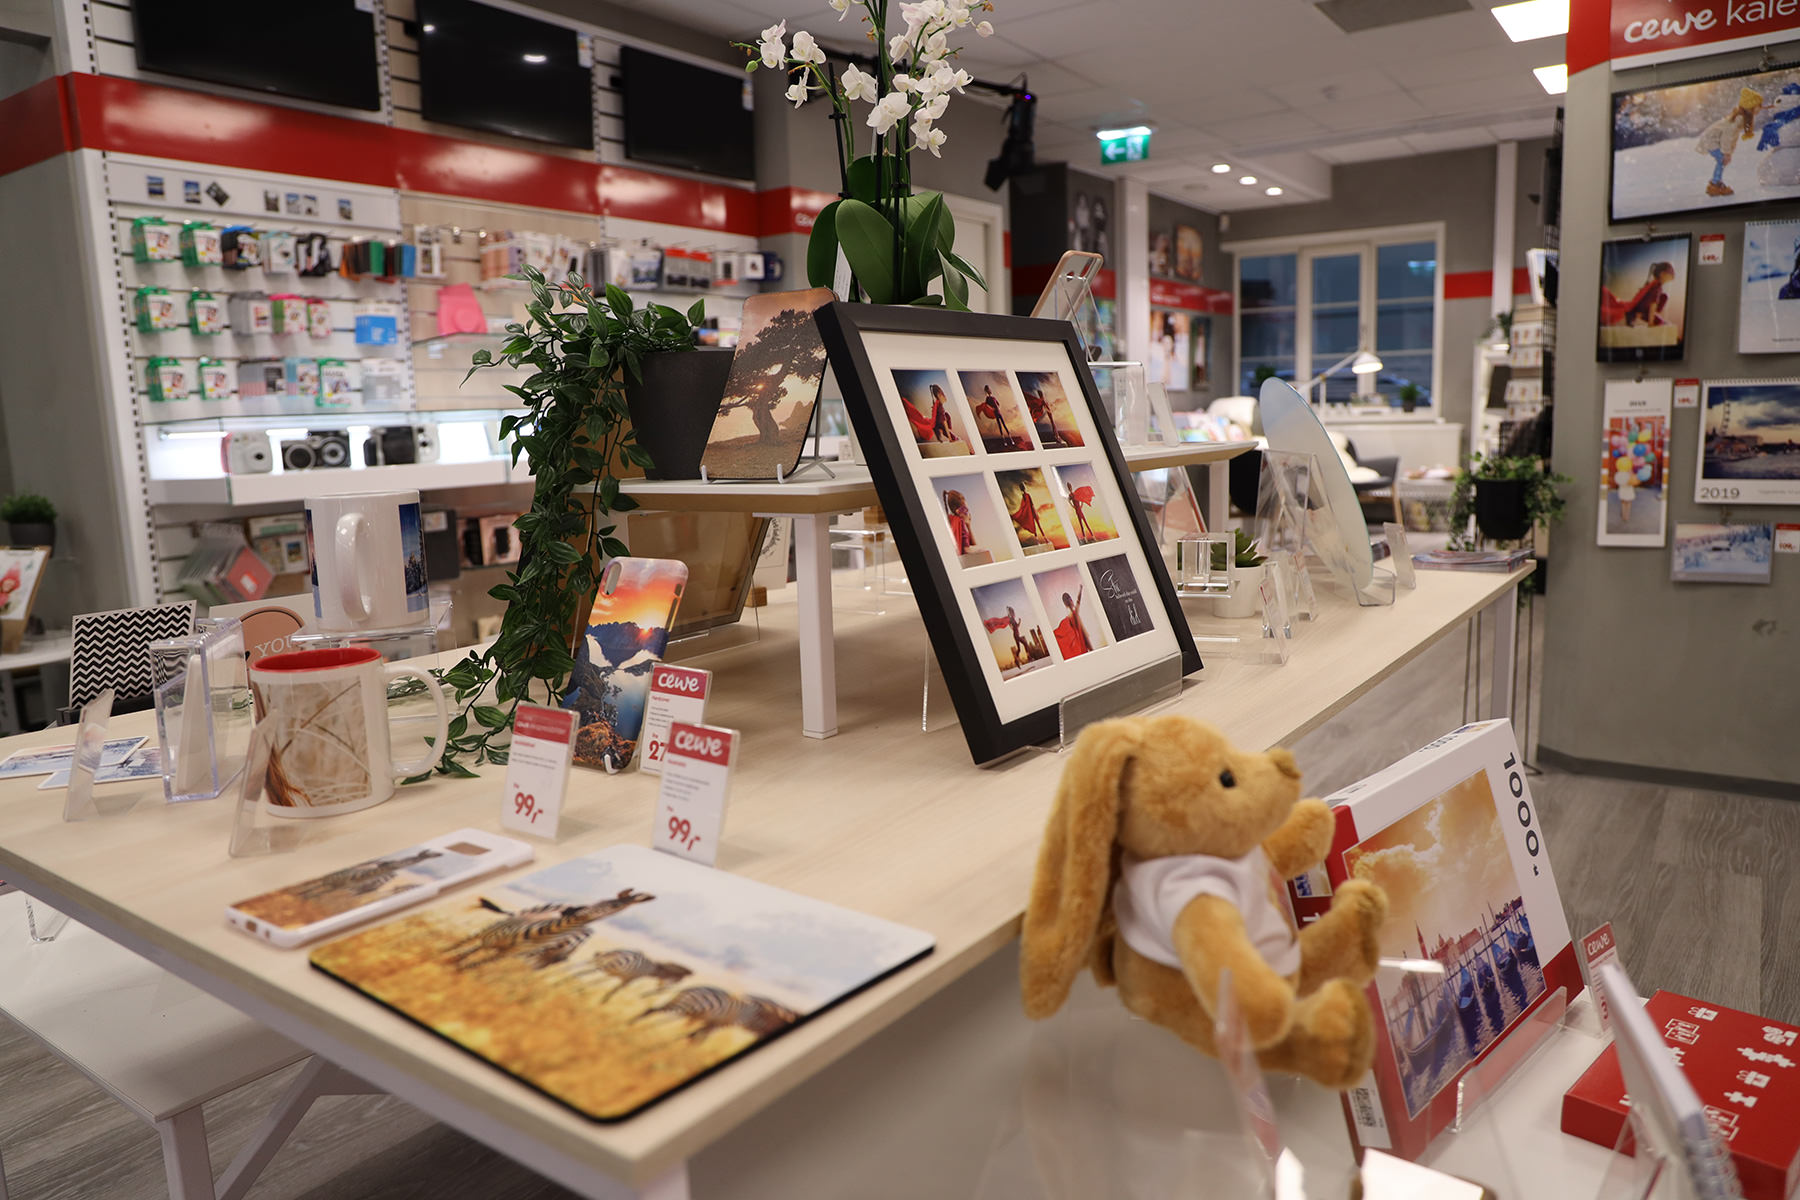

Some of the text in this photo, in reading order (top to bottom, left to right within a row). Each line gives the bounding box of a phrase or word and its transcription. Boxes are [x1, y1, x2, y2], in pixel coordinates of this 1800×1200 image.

[1624, 9, 1717, 43] cewe
[1701, 487, 1740, 499] 2019
[658, 672, 700, 692] cewe
[674, 730, 723, 757] cewe
[1587, 932, 1610, 956] cewe
